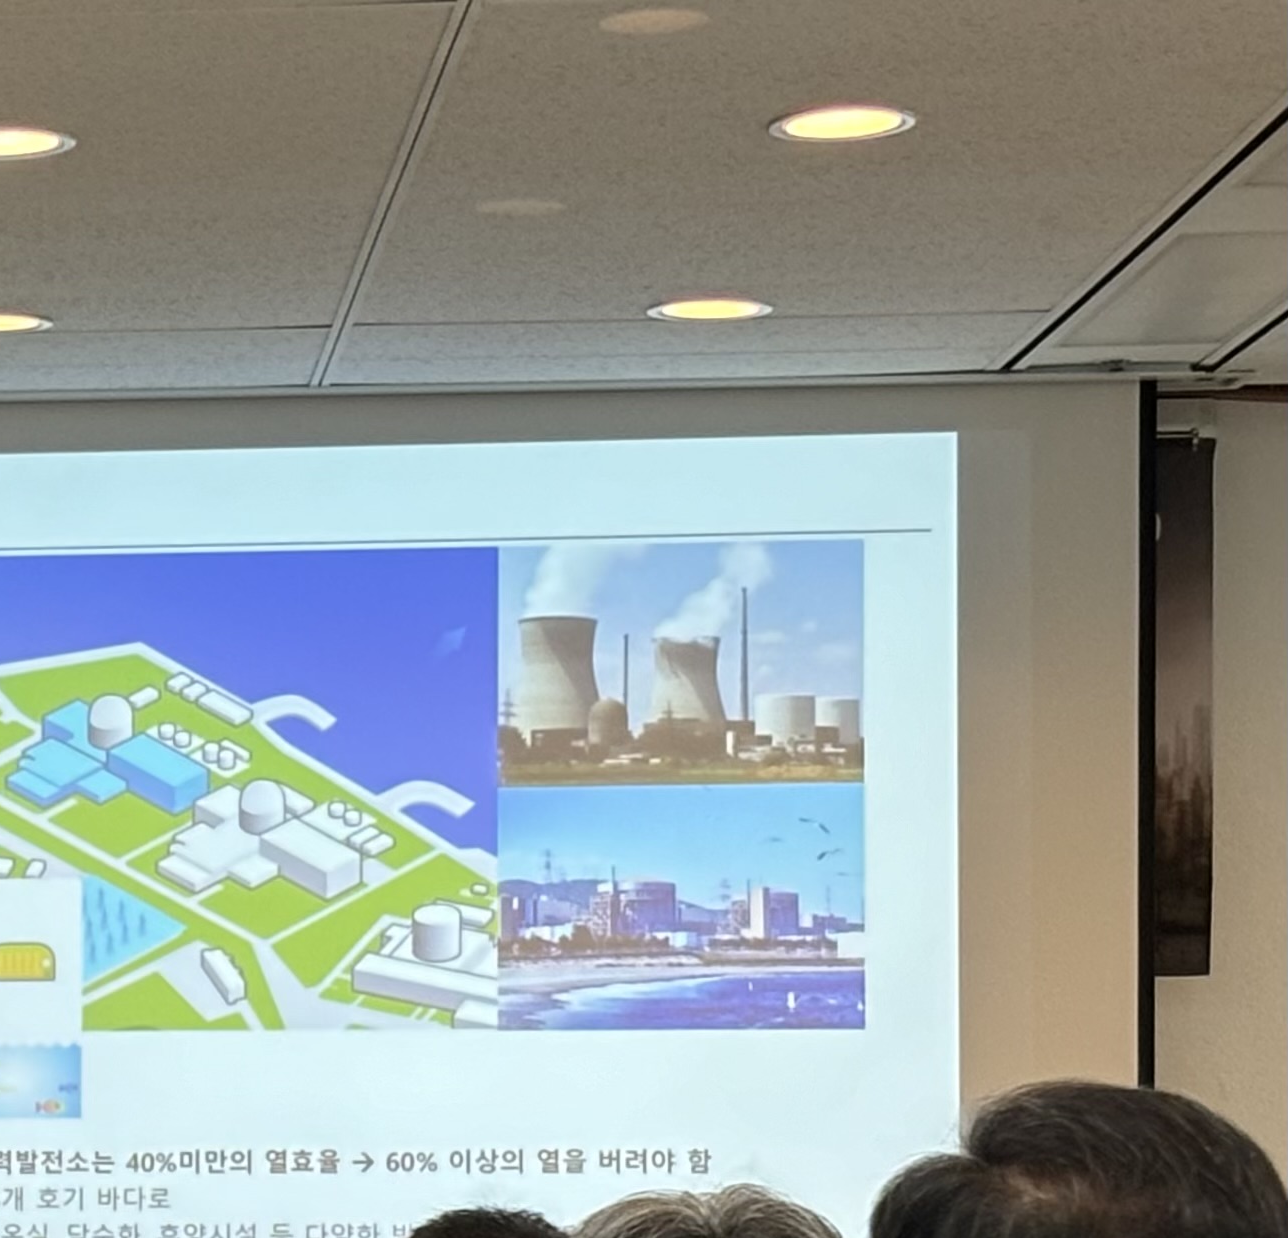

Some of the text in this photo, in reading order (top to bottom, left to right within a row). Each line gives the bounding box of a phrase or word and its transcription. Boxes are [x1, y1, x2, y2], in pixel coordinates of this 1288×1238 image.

[125, 1148, 253, 1176] 40%미만의
[265, 1148, 341, 1175] 열효율
[385, 1151, 438, 1173] 60%
[449, 1148, 524, 1175] 이상의
[537, 1148, 587, 1174] 열을
[598, 1148, 676, 1175] 버려야
[688, 1148, 712, 1175] 함
[36, 1186, 85, 1212] 호기
[97, 1186, 171, 1212] 바다로
